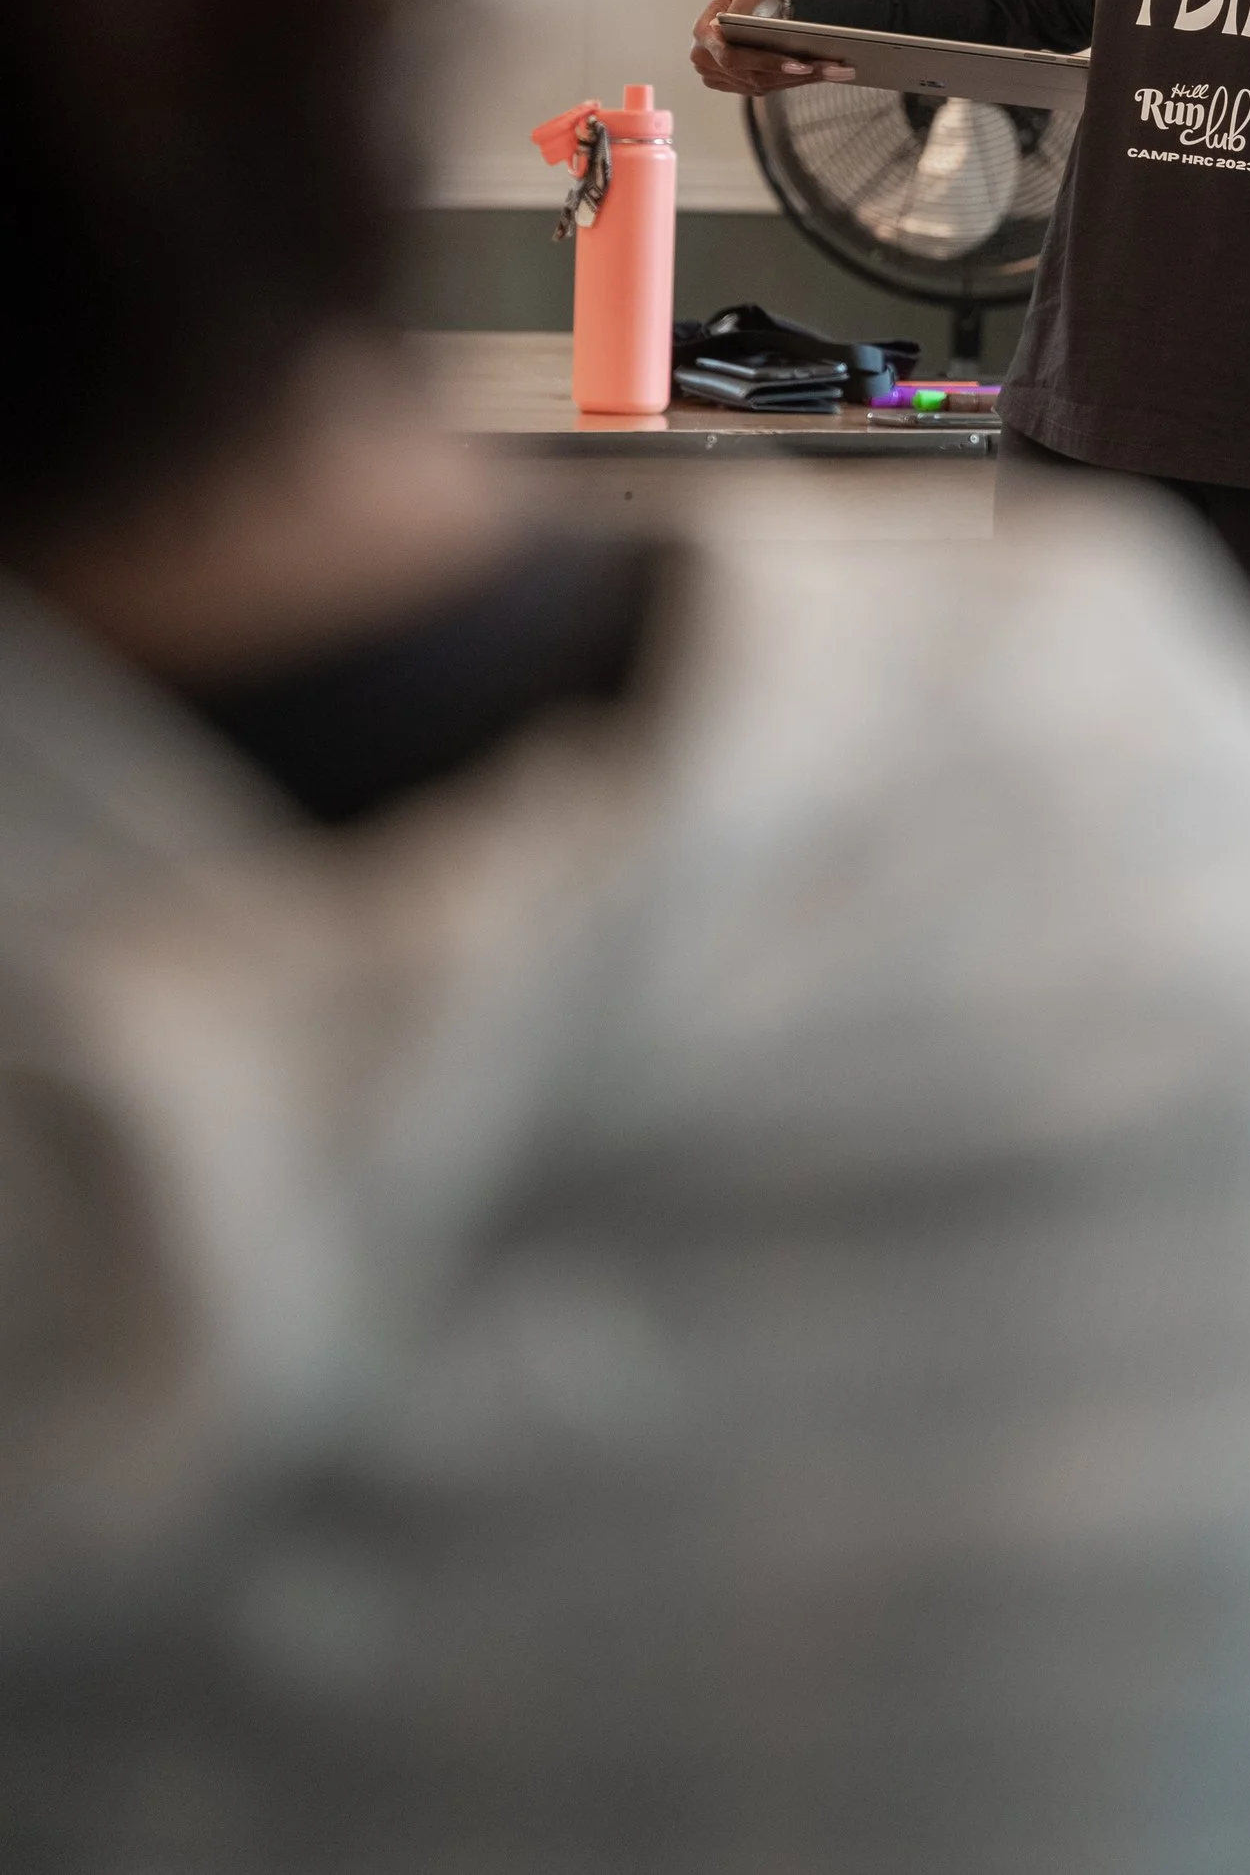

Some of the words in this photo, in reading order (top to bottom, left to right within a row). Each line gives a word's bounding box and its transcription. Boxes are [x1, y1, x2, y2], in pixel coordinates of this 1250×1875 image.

[1170, 83, 1210, 99] Hill
[1134, 88, 1205, 130] Run
[1127, 147, 1180, 162] CAMP
[1181, 154, 1214, 167] HRC
